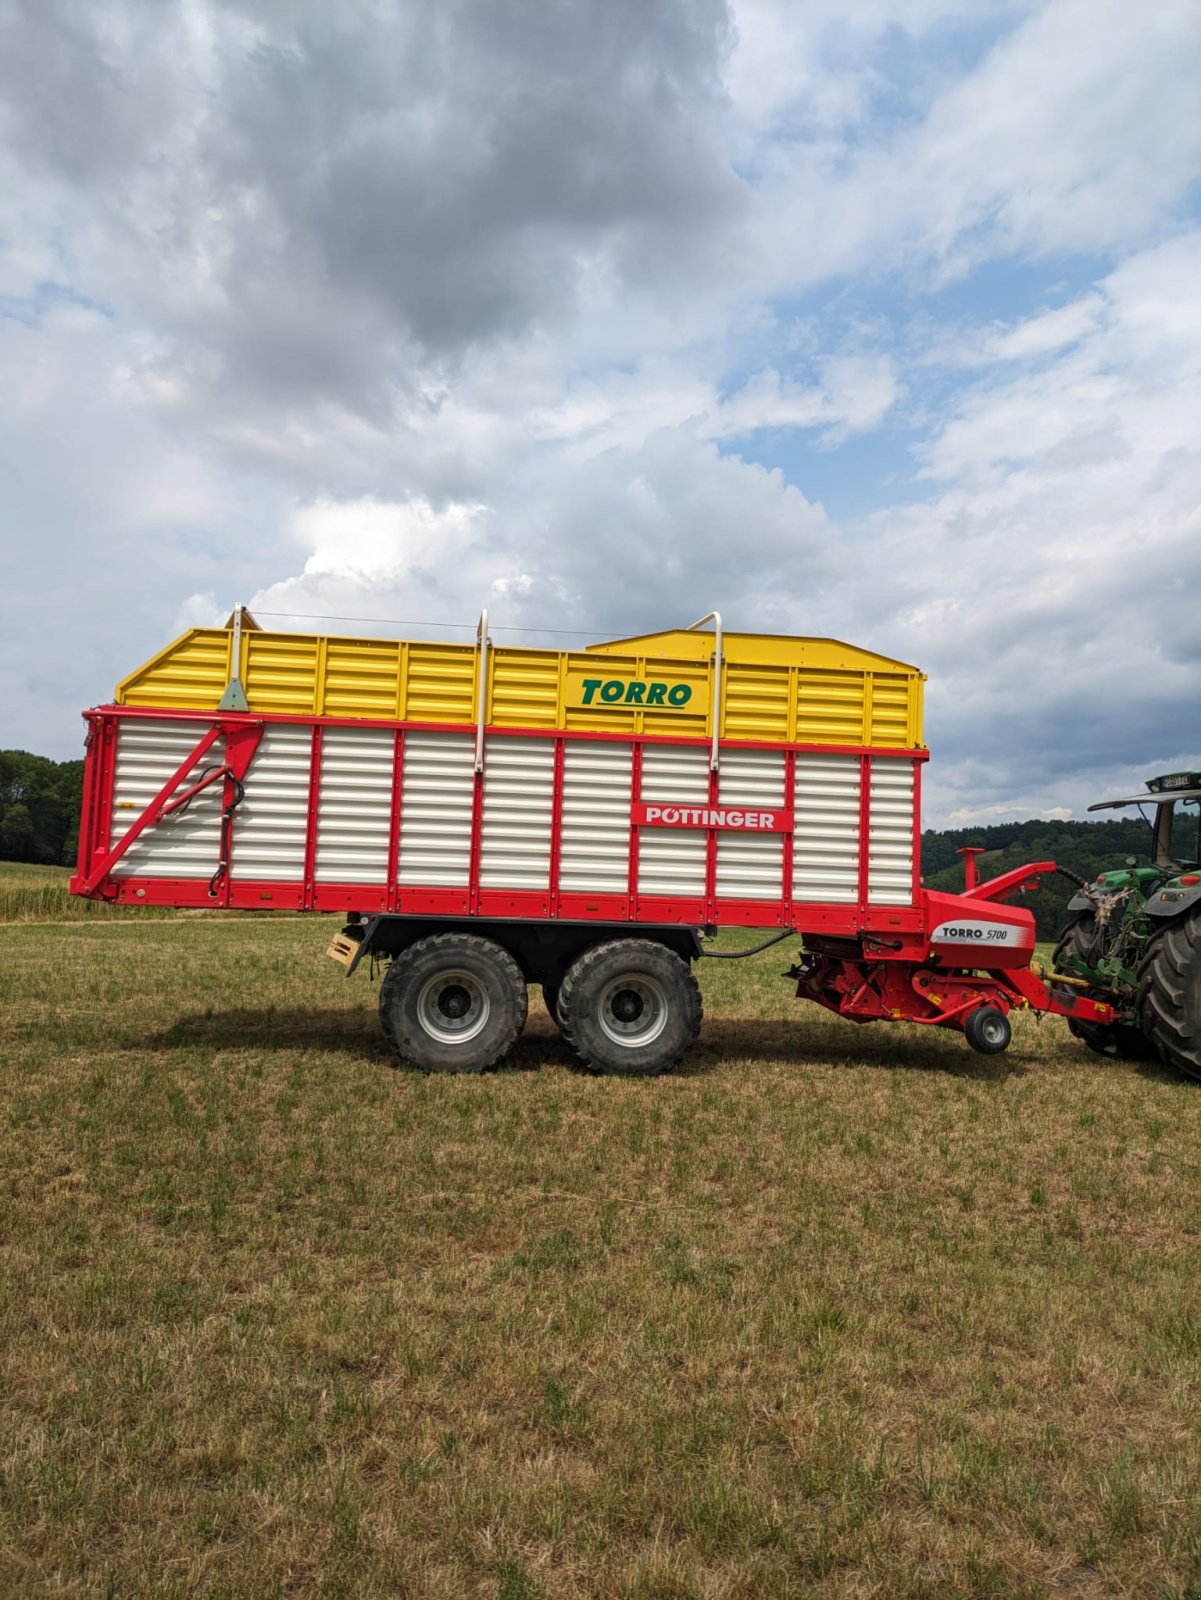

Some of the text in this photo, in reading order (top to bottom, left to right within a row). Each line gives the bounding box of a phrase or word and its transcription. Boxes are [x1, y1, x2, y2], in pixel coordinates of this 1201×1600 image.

[581, 679, 693, 706] TORRO
[942, 927, 1008, 940] TORRO 5700
